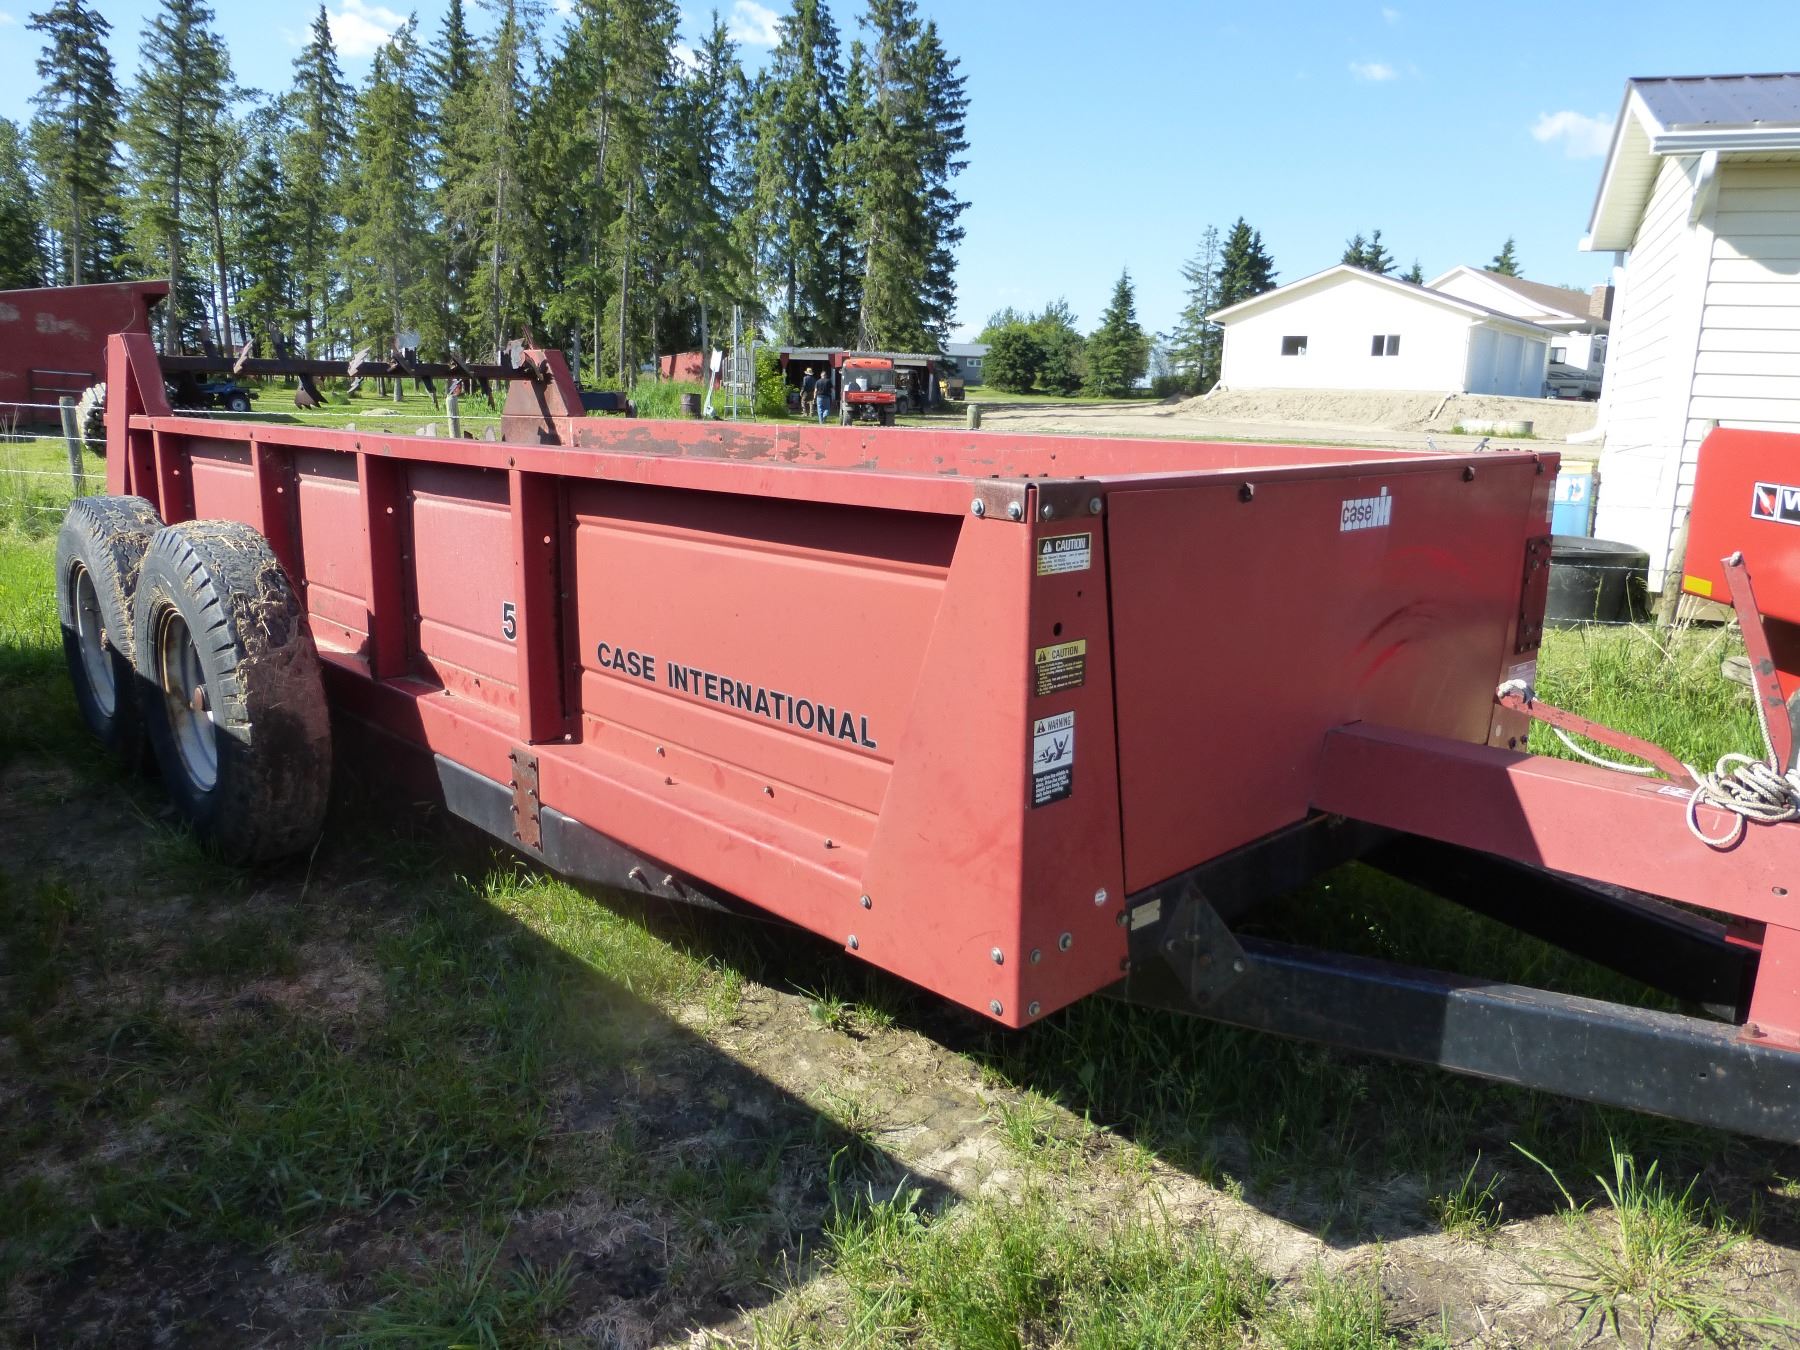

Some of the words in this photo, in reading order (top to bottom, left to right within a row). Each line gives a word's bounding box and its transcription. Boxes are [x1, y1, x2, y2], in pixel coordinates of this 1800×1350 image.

[1055, 537, 1086, 552] CAUTION
[502, 602, 517, 641] 5
[1051, 645, 1079, 659] CAUTION
[597, 642, 656, 682] CASE
[667, 662, 878, 750] INTERNATIONAL
[1047, 715, 1071, 731] WARNING
